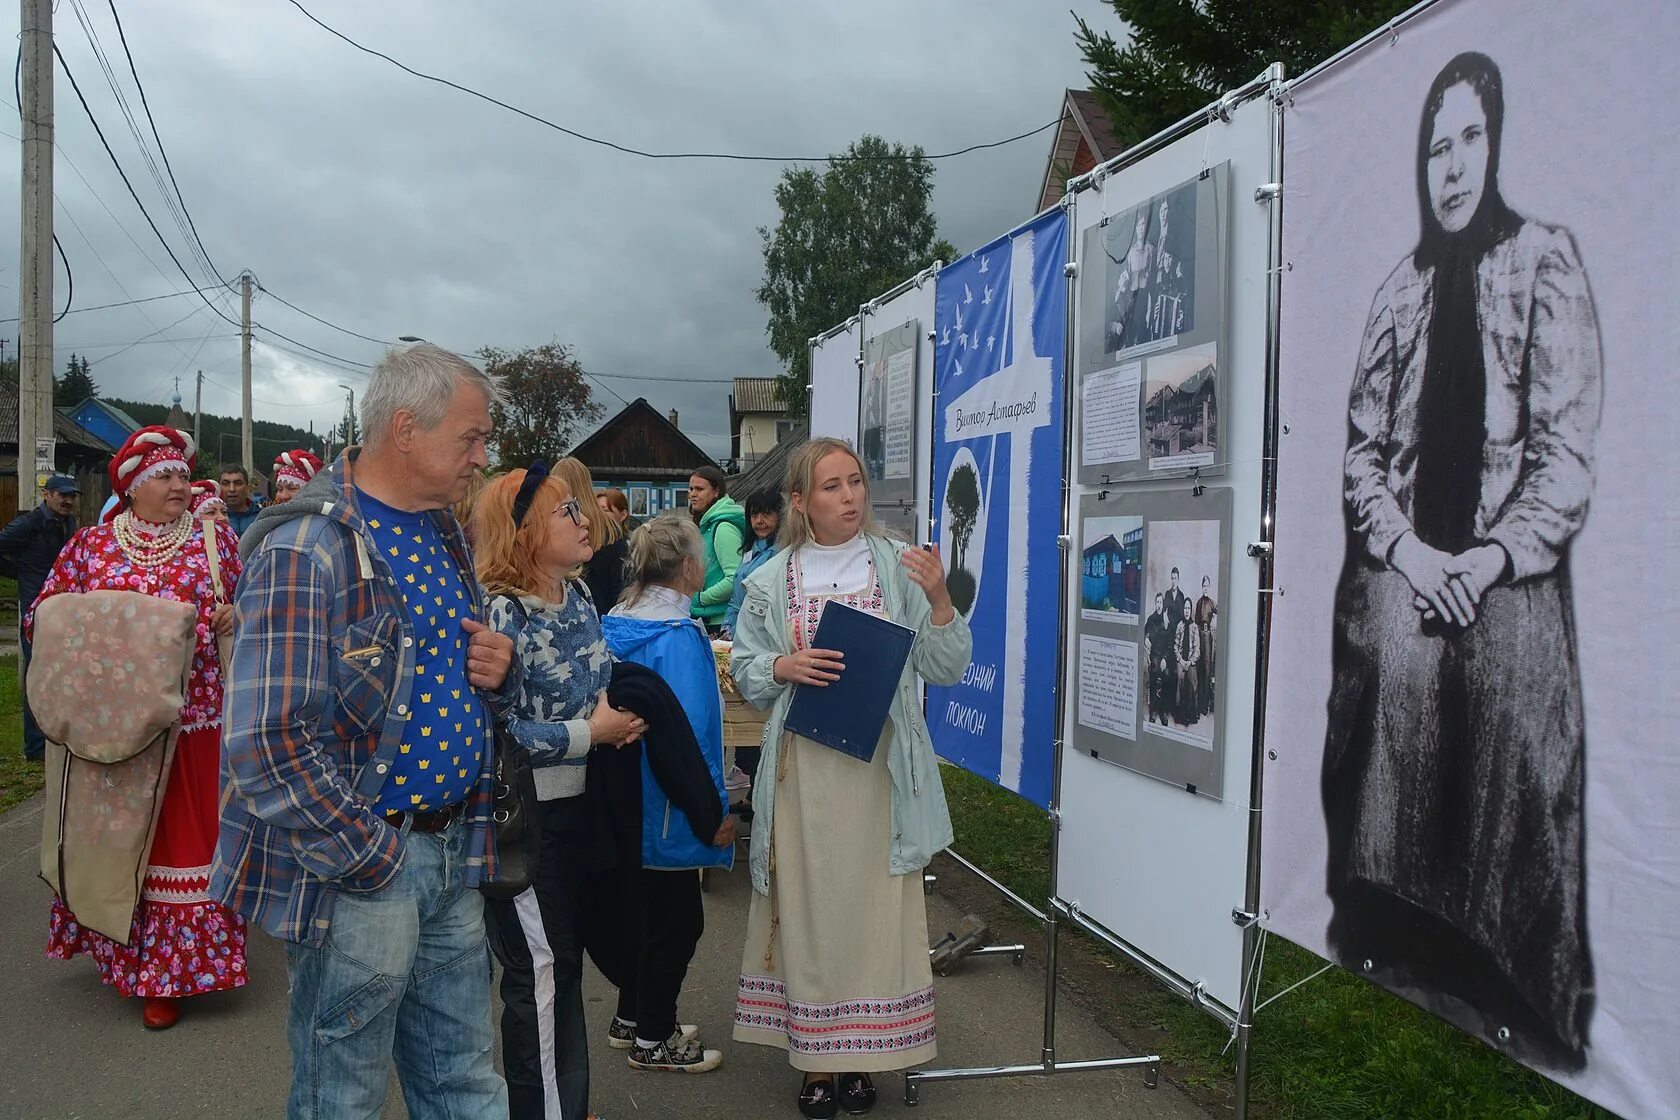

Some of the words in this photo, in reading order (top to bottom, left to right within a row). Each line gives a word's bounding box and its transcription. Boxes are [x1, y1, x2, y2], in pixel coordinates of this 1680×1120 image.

[956, 408, 986, 432] Виктор
[986, 391, 1037, 426] Астафьев
[961, 661, 997, 693] ЕДНИЙ
[945, 701, 987, 737] ПОКЛОН
